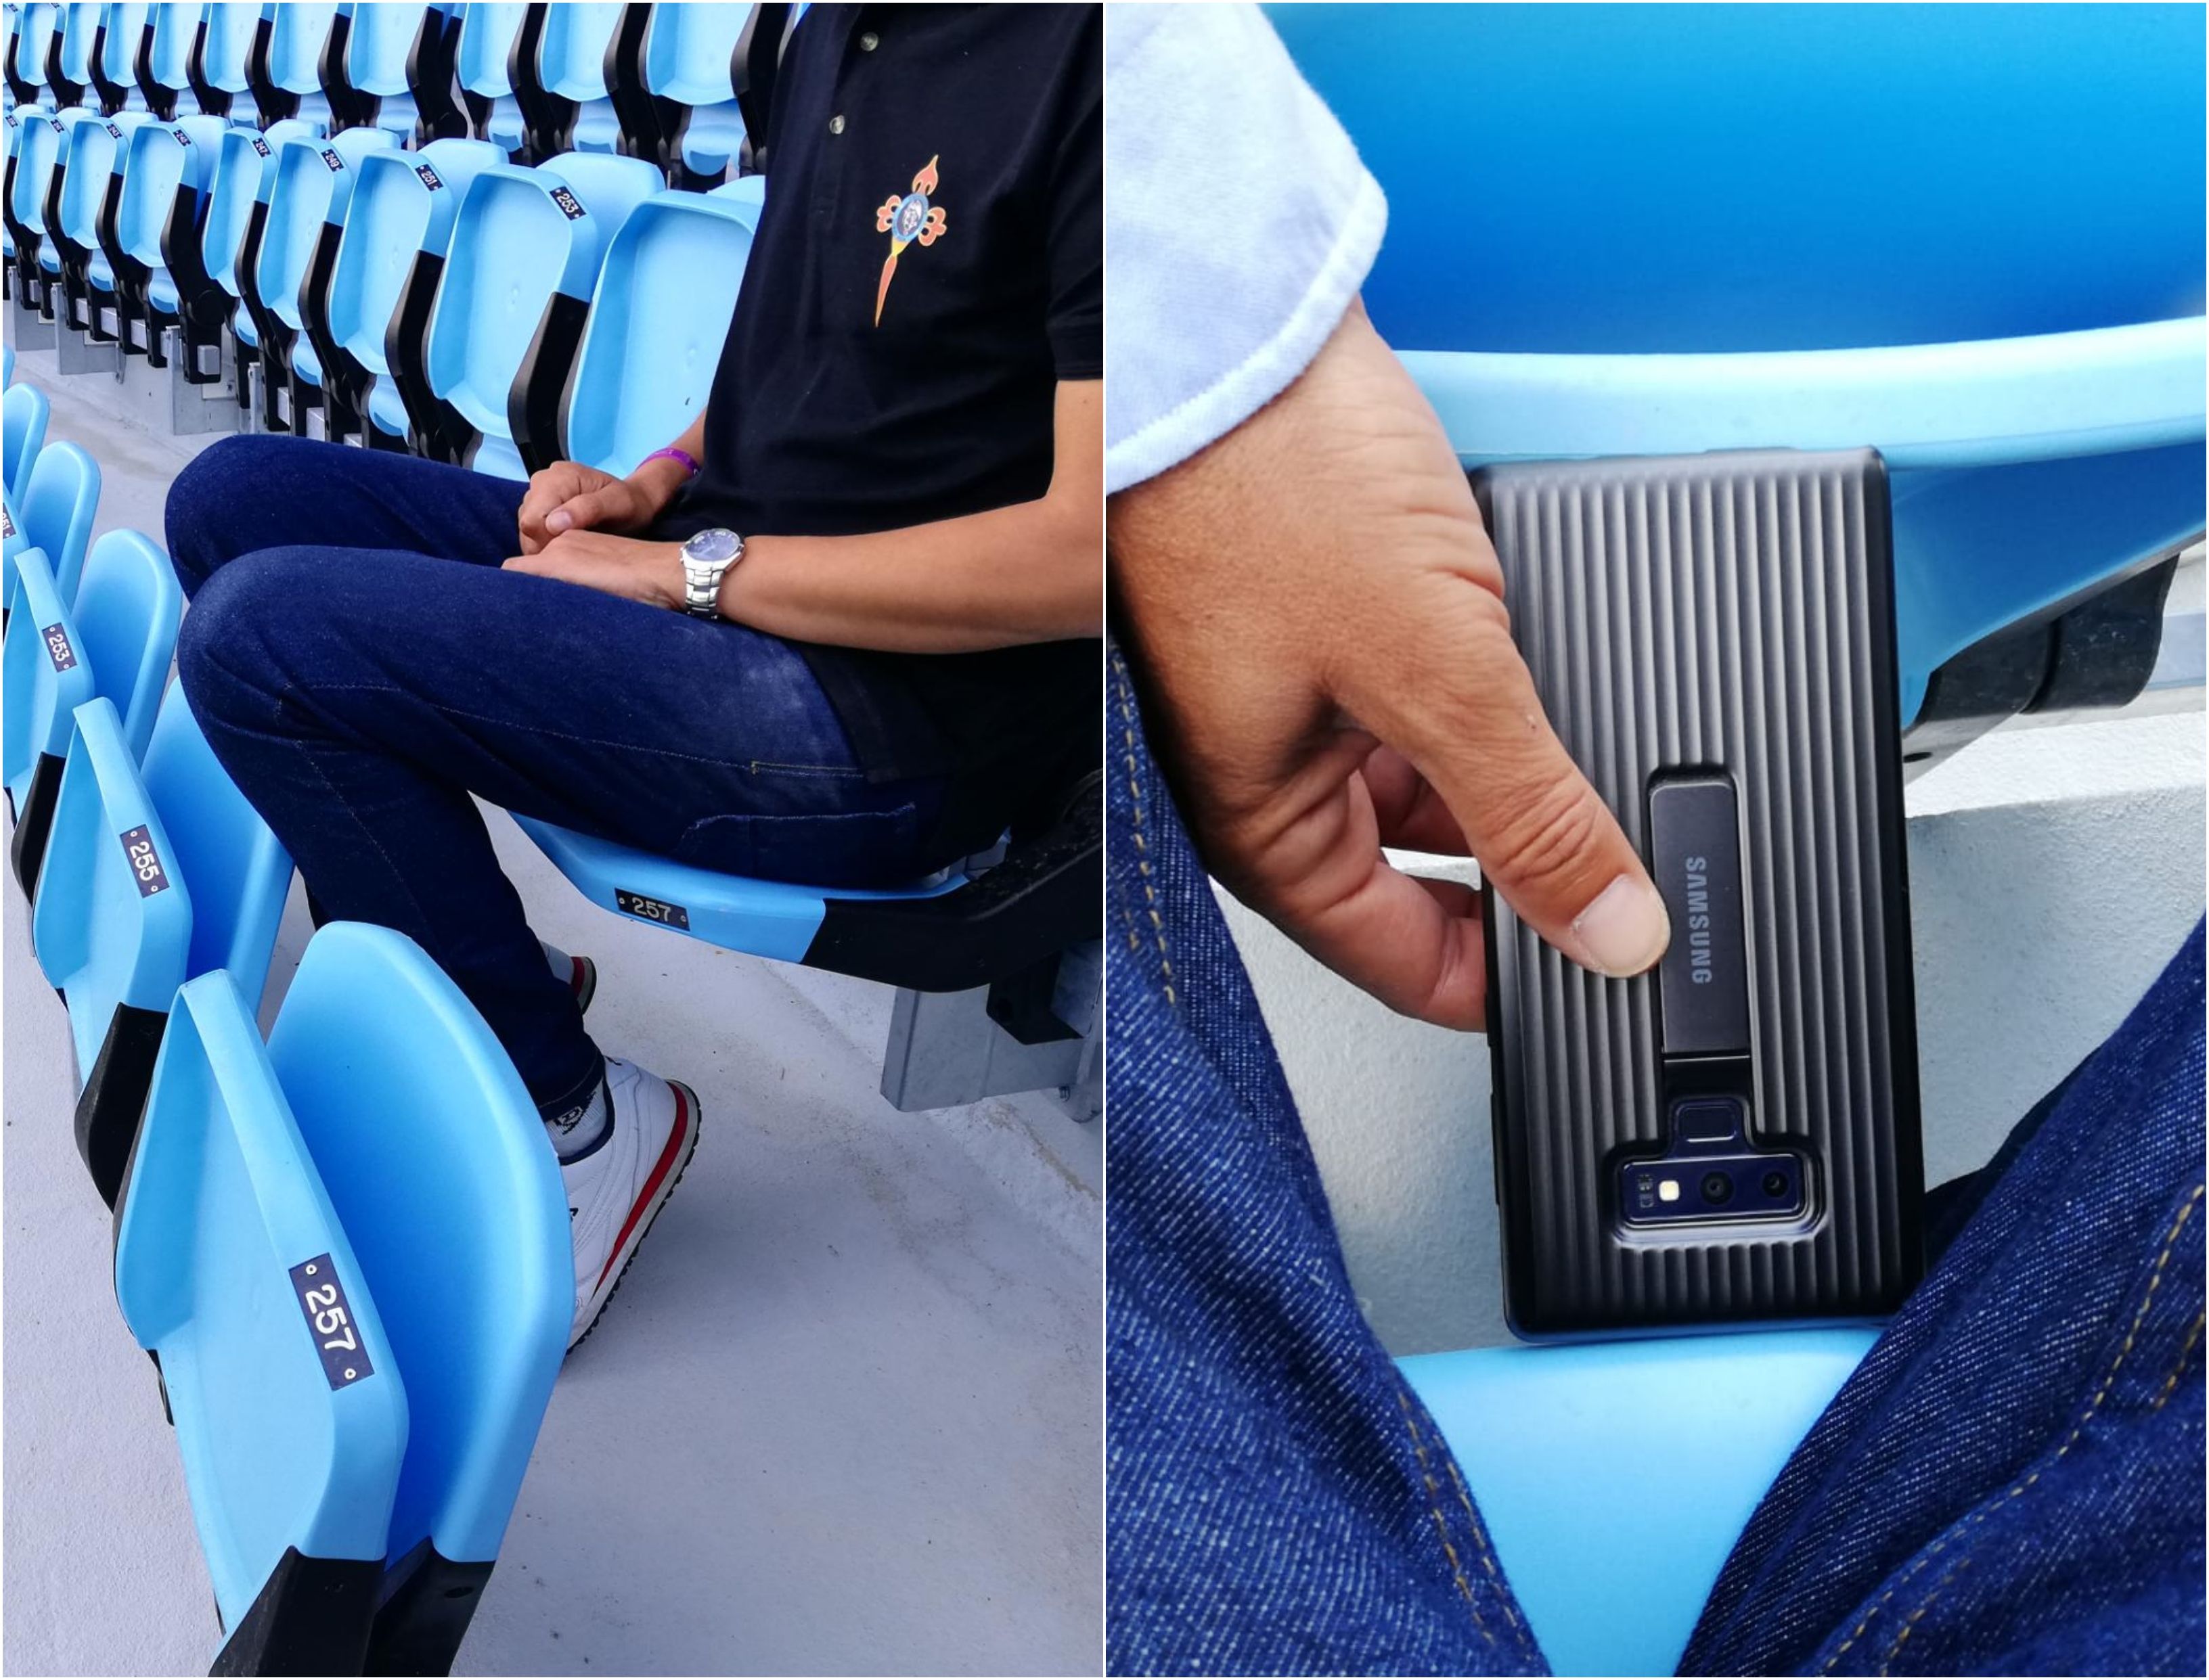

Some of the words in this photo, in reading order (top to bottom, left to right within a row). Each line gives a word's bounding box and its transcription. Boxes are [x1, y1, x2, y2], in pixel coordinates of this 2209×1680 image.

[256, 141, 268, 153] 247
[326, 153, 340, 167] 249
[421, 171, 438, 185] 251
[556, 193, 579, 212] 253
[48, 633, 70, 662] 253
[129, 841, 160, 881] 255
[632, 896, 671, 922] 257
[1685, 856, 1713, 984] SAMSUNG
[305, 1284, 357, 1350] 257
